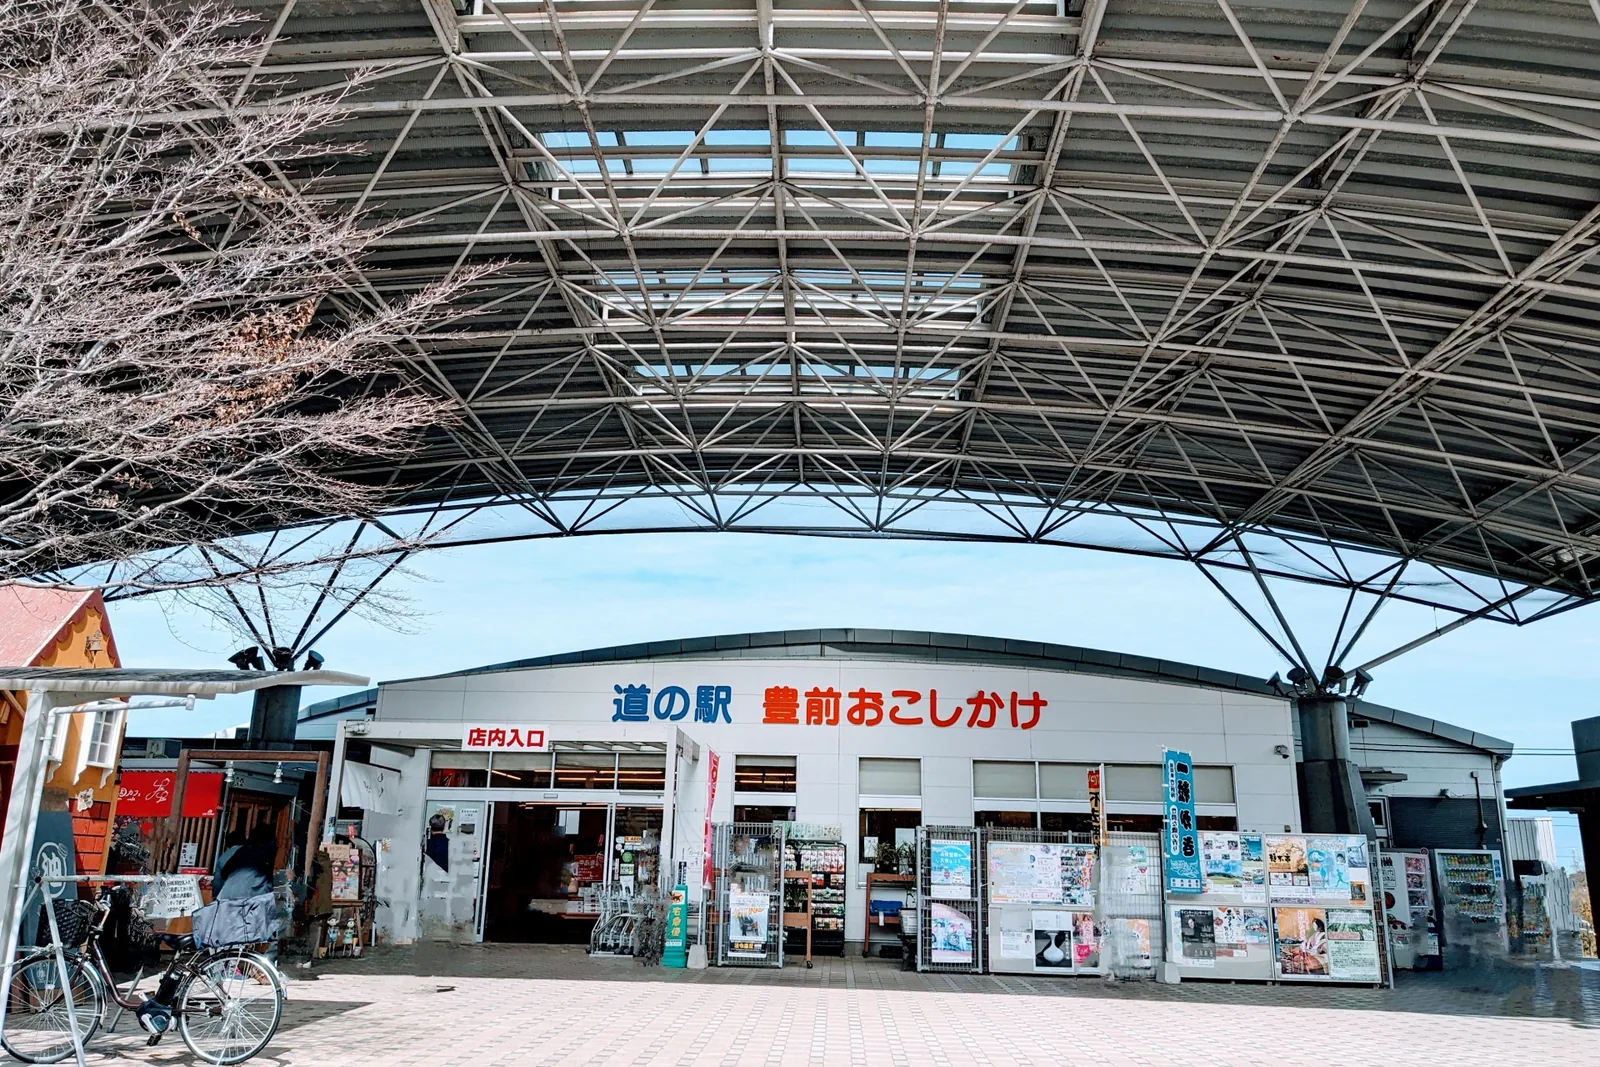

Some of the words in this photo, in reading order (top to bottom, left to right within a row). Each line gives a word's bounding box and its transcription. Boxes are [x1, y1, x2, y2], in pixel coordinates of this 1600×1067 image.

[612, 683, 732, 723] 道の駅
[762, 685, 1048, 730] 豊前おこしかけ
[467, 727, 545, 748] 店内入口
